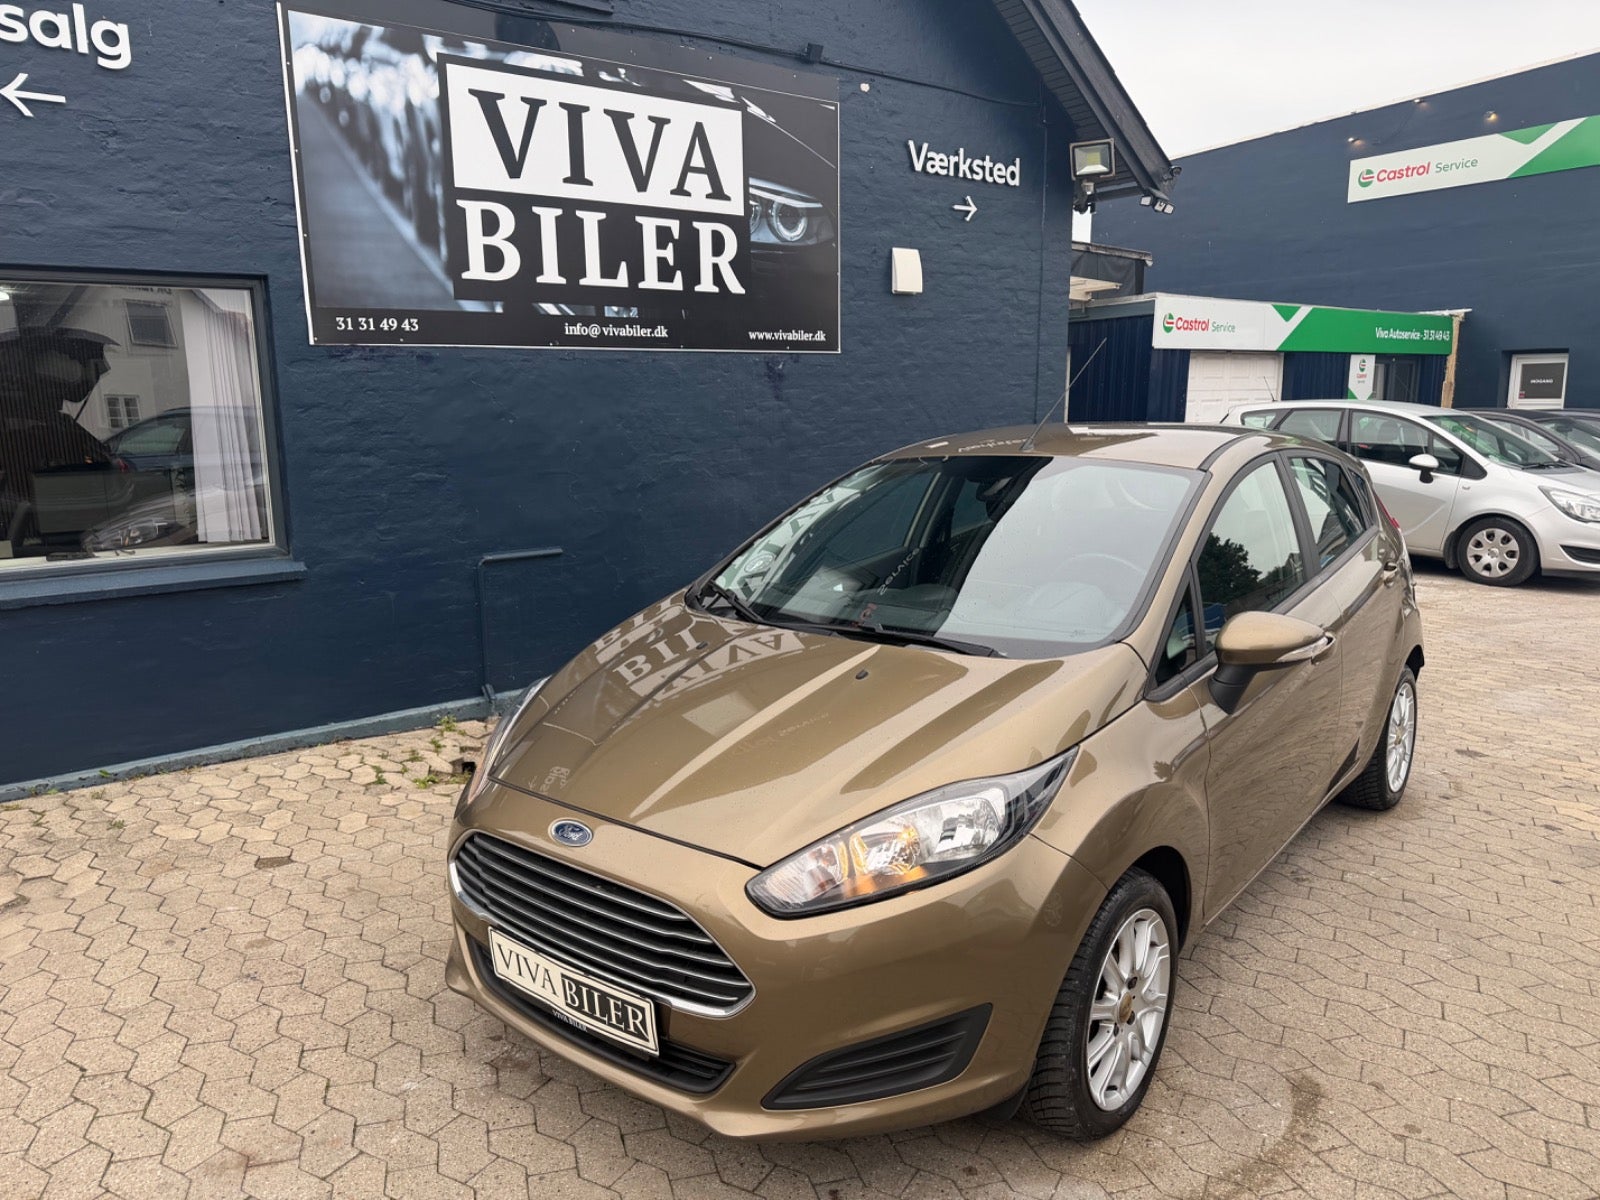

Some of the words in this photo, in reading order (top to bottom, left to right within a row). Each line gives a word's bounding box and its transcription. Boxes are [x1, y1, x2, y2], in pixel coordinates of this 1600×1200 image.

[468, 88, 732, 201] VIVA
[908, 139, 1021, 187] Værksted
[1376, 162, 1431, 182] Castrol
[1435, 158, 1479, 174] Service
[456, 199, 746, 294] BILER
[335, 316, 354, 331] 31
[358, 317, 376, 331] 31
[379, 317, 398, 331] 49
[400, 318, 419, 332] 43
[564, 323, 668, 338] info@vivabiler.dk
[1175, 317, 1210, 332] Castrol
[1211, 321, 1236, 333] Service
[1375, 327, 1388, 338] Viva
[748, 330, 826, 342] www.vivabiler.dk
[496, 943, 559, 998] VIVA
[562, 978, 650, 1042] BILER
